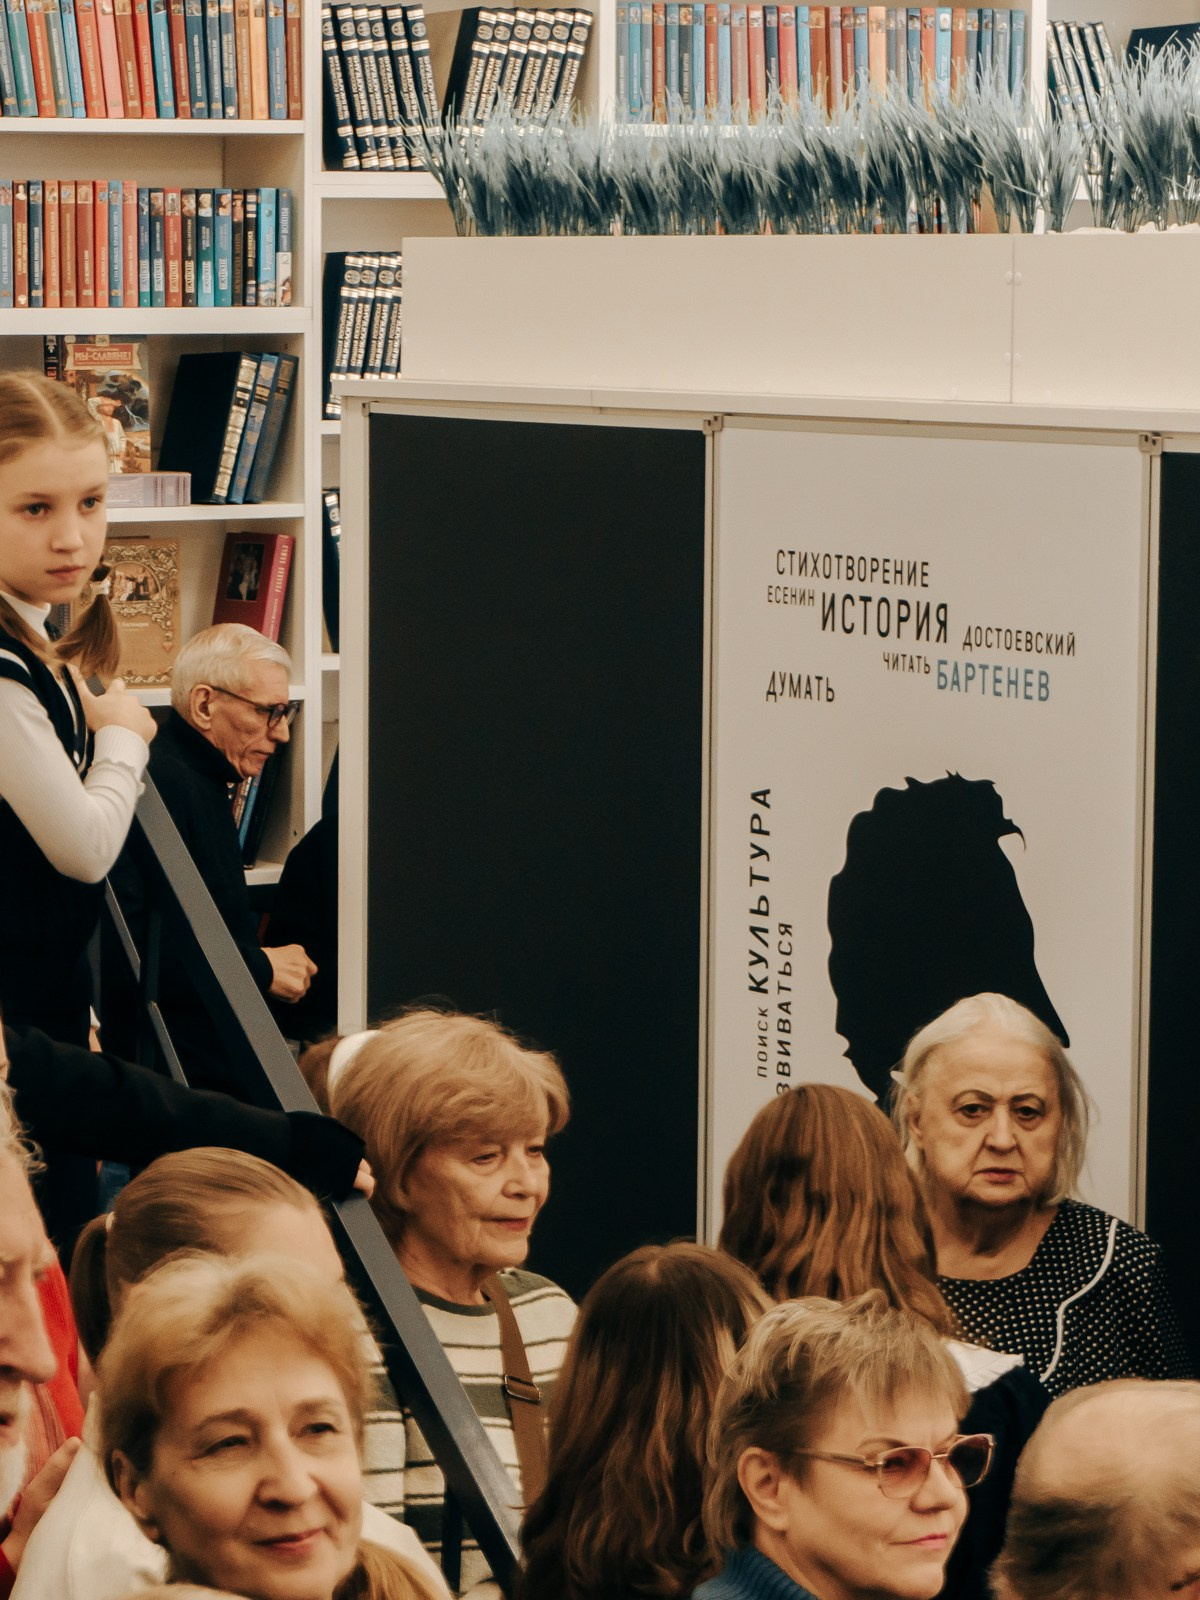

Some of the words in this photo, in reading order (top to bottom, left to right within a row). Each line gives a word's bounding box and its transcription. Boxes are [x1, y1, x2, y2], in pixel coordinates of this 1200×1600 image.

[776, 549, 930, 587] СТИХОТВОРЕНИЕ
[767, 585, 815, 607] ЕСЕНИН
[822, 592, 948, 643] ИСТОРИЯ
[962, 626, 1075, 656] ДОСТОЕВСКИЙ
[766, 671, 835, 702] ДУМАТЬ
[883, 652, 931, 674] ЧИТАТЬ
[937, 659, 1050, 701] БАРТЕНЕВ
[748, 788, 771, 995] КУЛЬТУРА
[757, 1007, 768, 1079] ПОИСК
